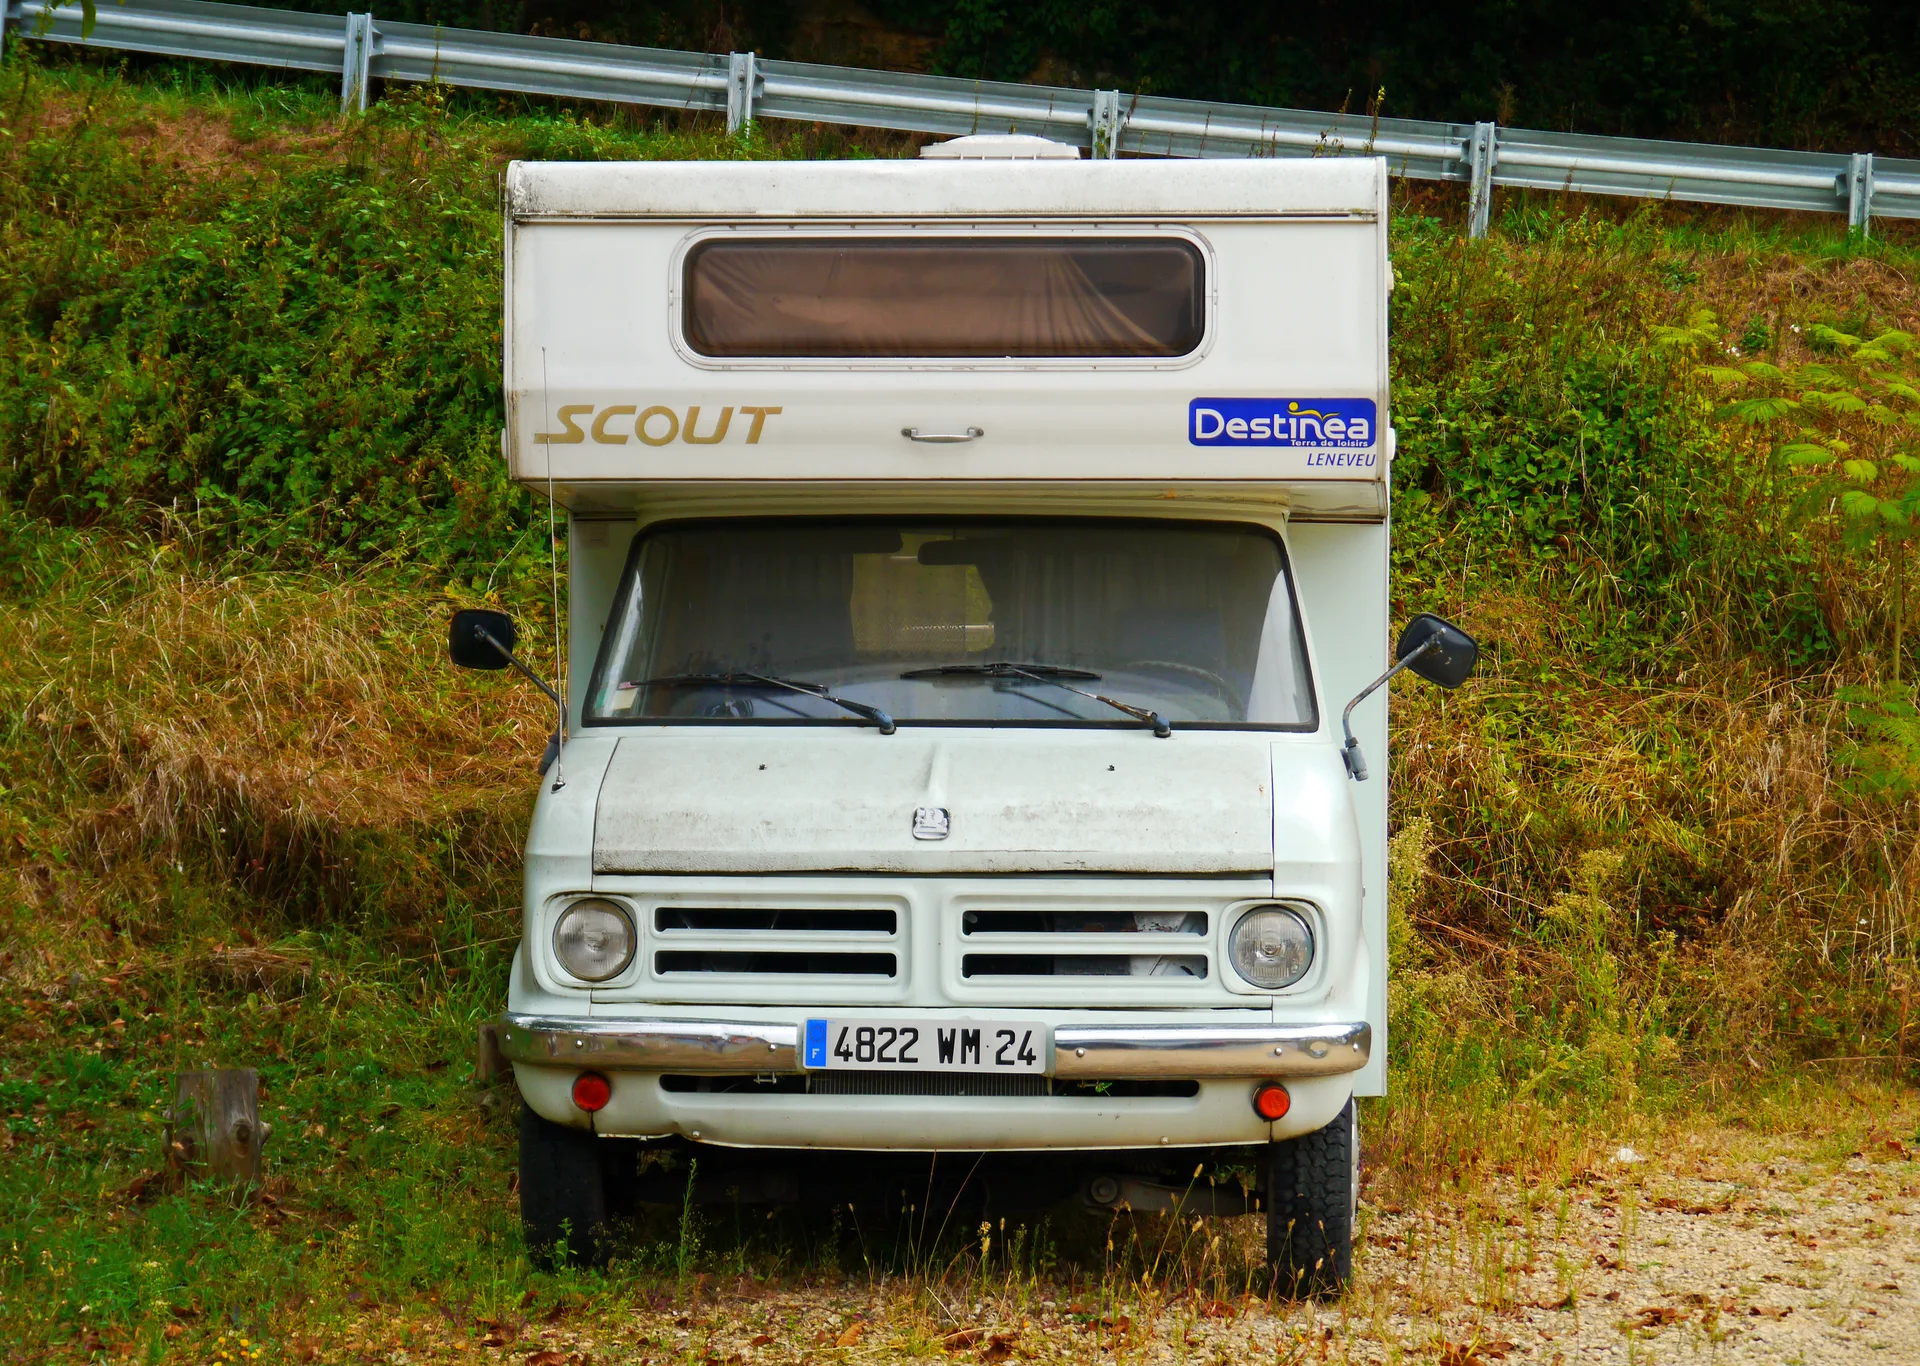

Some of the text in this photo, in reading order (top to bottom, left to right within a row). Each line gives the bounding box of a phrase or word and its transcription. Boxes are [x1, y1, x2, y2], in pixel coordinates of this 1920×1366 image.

[533, 404, 783, 447] SCOUT
[1195, 402, 1369, 440] Destinea
[1290, 439, 1369, 448] Terre de loisirs
[1307, 453, 1376, 467] LENEVEU
[811, 1048, 820, 1059] F
[833, 1026, 1036, 1066] 4822 WM 24
